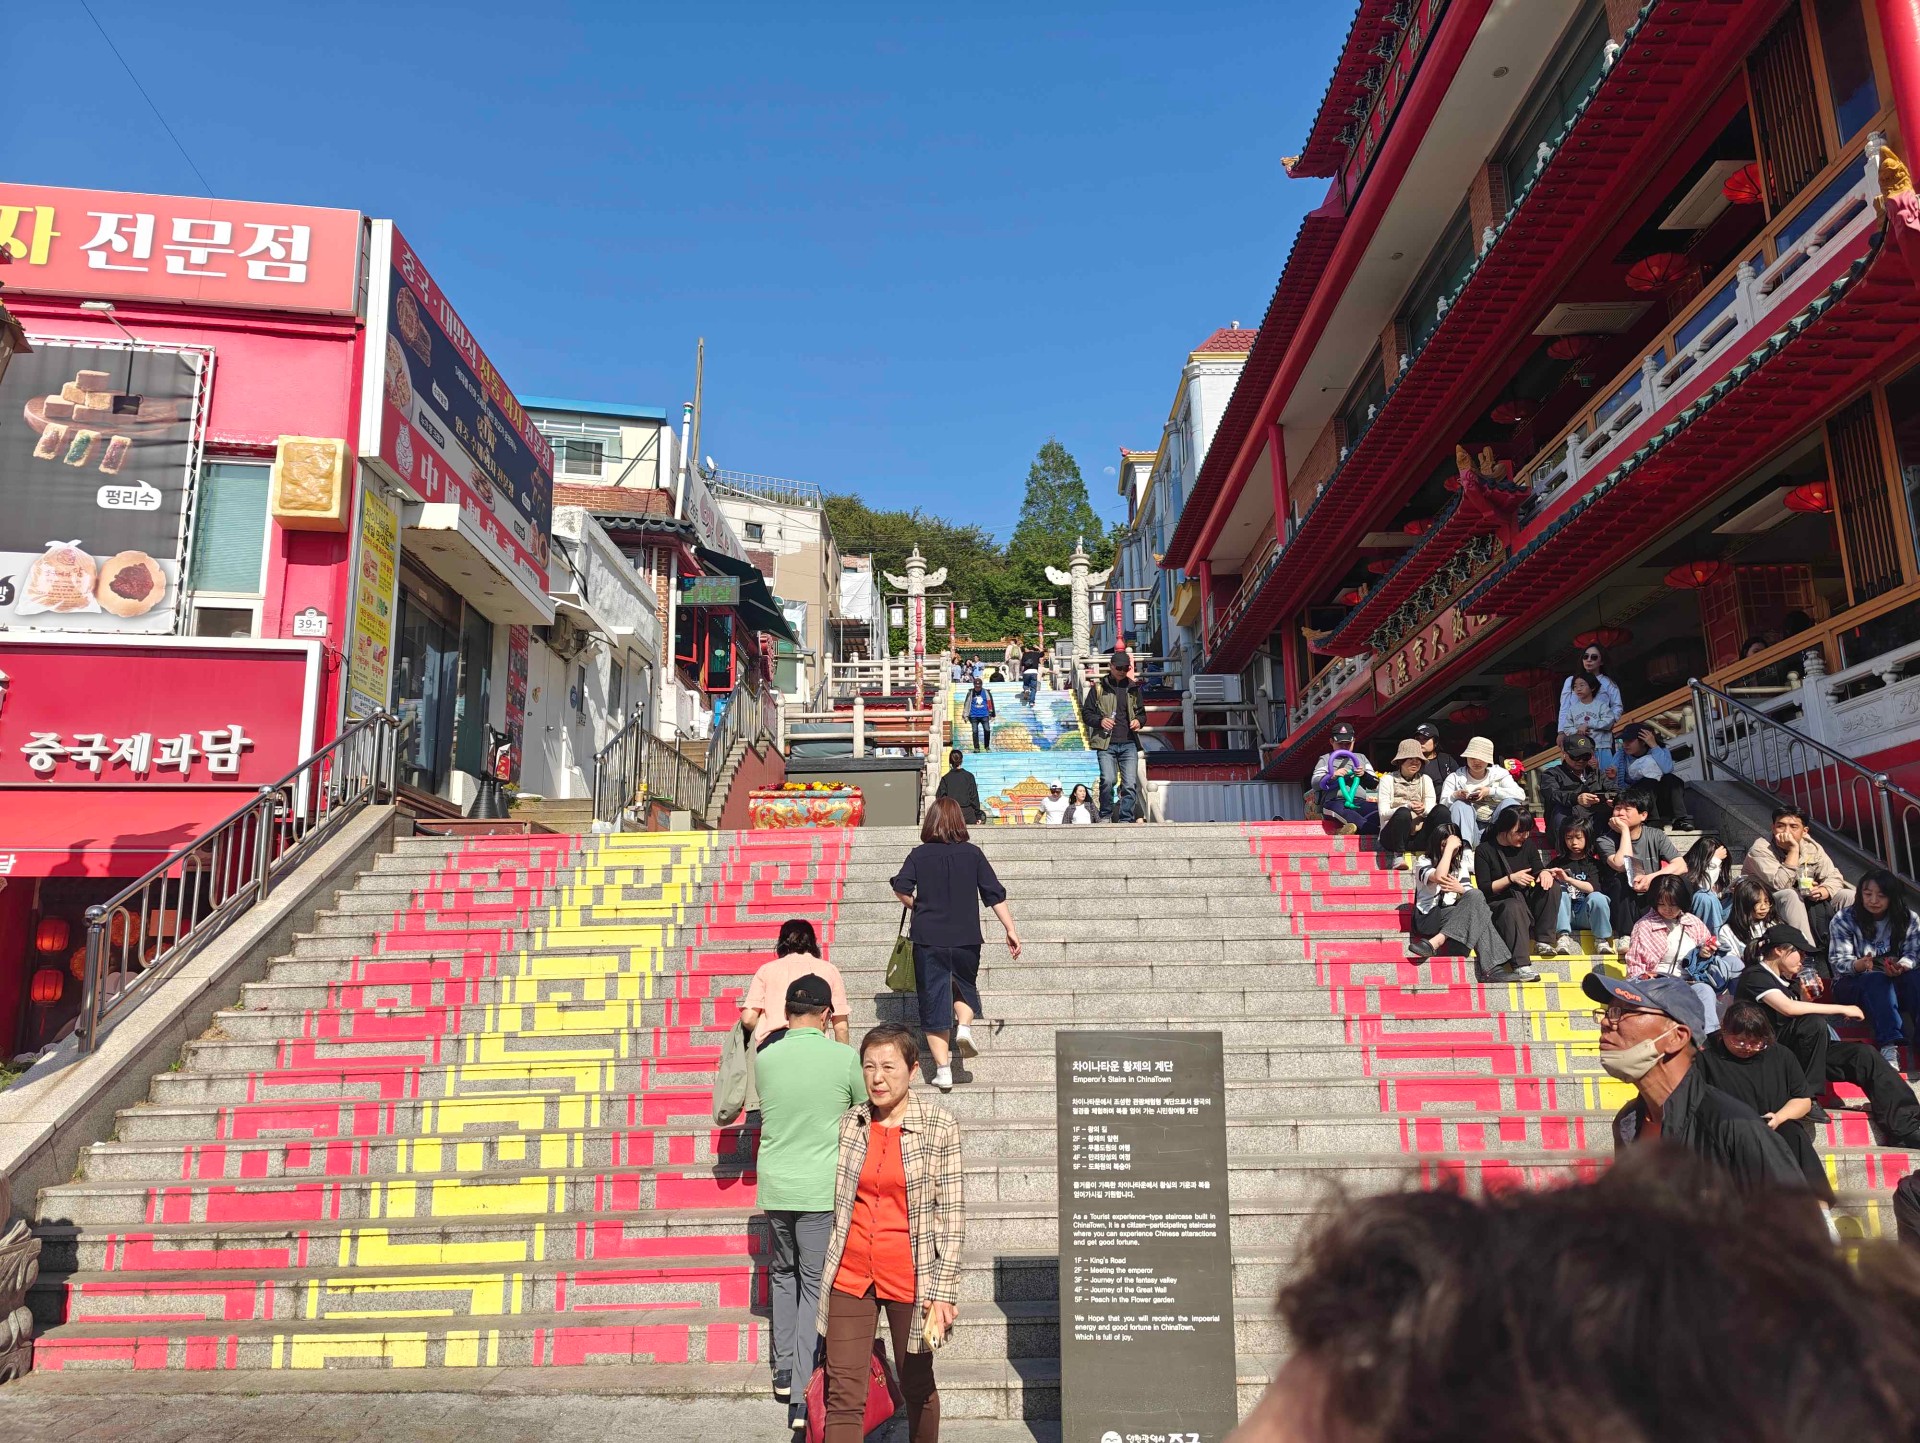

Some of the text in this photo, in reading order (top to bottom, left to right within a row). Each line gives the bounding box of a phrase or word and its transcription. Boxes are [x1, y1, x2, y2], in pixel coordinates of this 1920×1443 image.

[80, 211, 311, 283] 전문점
[400, 242, 549, 471] 중국 대만식 전통 과자 전문점
[104, 489, 155, 507] 펑리수
[298, 620, 322, 628] 39-1
[20, 724, 254, 774] 중국제과담
[1072, 1060, 1174, 1073] 차이나타운 황제의 계단
[1072, 1075, 1172, 1083] Emperor's Stairs in ChinaTown
[1072, 1097, 1112, 1106] 차이나타운에서
[1162, 1097, 1192, 1106] 계단으로서
[1192, 1097, 1212, 1106] 중국의
[1142, 1106, 1156, 1115] 가는
[1156, 1106, 1186, 1115] 시민참여형
[1186, 1106, 1198, 1115] 계단
[1072, 1125, 1080, 1134] 1F
[1072, 1134, 1080, 1143] 2F
[1072, 1143, 1080, 1152] 3F
[1072, 1153, 1080, 1162] 4F
[1072, 1162, 1082, 1171] 5F
[1118, 1180, 1158, 1190] 차이나타운에서
[1072, 1212, 1082, 1221] As
[1082, 1212, 1088, 1221] a
[1090, 1212, 1110, 1221] Tourist
[1164, 1212, 1192, 1221] staircase
[1194, 1212, 1208, 1221] built
[1210, 1212, 1216, 1221] in
[1114, 1221, 1120, 1230] is
[1120, 1221, 1126, 1230] a
[1188, 1221, 1216, 1230] staircase
[1072, 1229, 1092, 1238] where
[1092, 1229, 1104, 1238] you
[1106, 1229, 1118, 1238] can
[1118, 1229, 1154, 1238] experience
[1154, 1229, 1180, 1238] Chinese
[1072, 1238, 1140, 1247] and get good fortune.
[1074, 1256, 1126, 1265] 1F King's Road
[1074, 1266, 1154, 1275] 2F Meeting the emperor
[1074, 1276, 1178, 1285] 3F Journey of the fantasy valley
[1074, 1285, 1168, 1294] 4F Journey of the Great Wall
[1074, 1295, 1082, 1304] 5F
[1090, 1295, 1110, 1304] Peach
[1118, 1295, 1130, 1304] the
[1130, 1295, 1152, 1304] Flower
[1152, 1295, 1176, 1304] garden
[1074, 1314, 1084, 1323] We
[1088, 1314, 1106, 1323] Hope
[1108, 1314, 1120, 1323] that
[1122, 1314, 1136, 1323] you
[1138, 1314, 1148, 1323] will
[1152, 1314, 1174, 1323] receive
[1178, 1314, 1188, 1323] the
[1074, 1323, 1096, 1332] energy
[1098, 1323, 1110, 1332] and
[1112, 1323, 1128, 1332] good
[1130, 1323, 1152, 1332] fortune
[1152, 1323, 1160, 1332] in
[1074, 1333, 1134, 1342] Which is full of joy.
